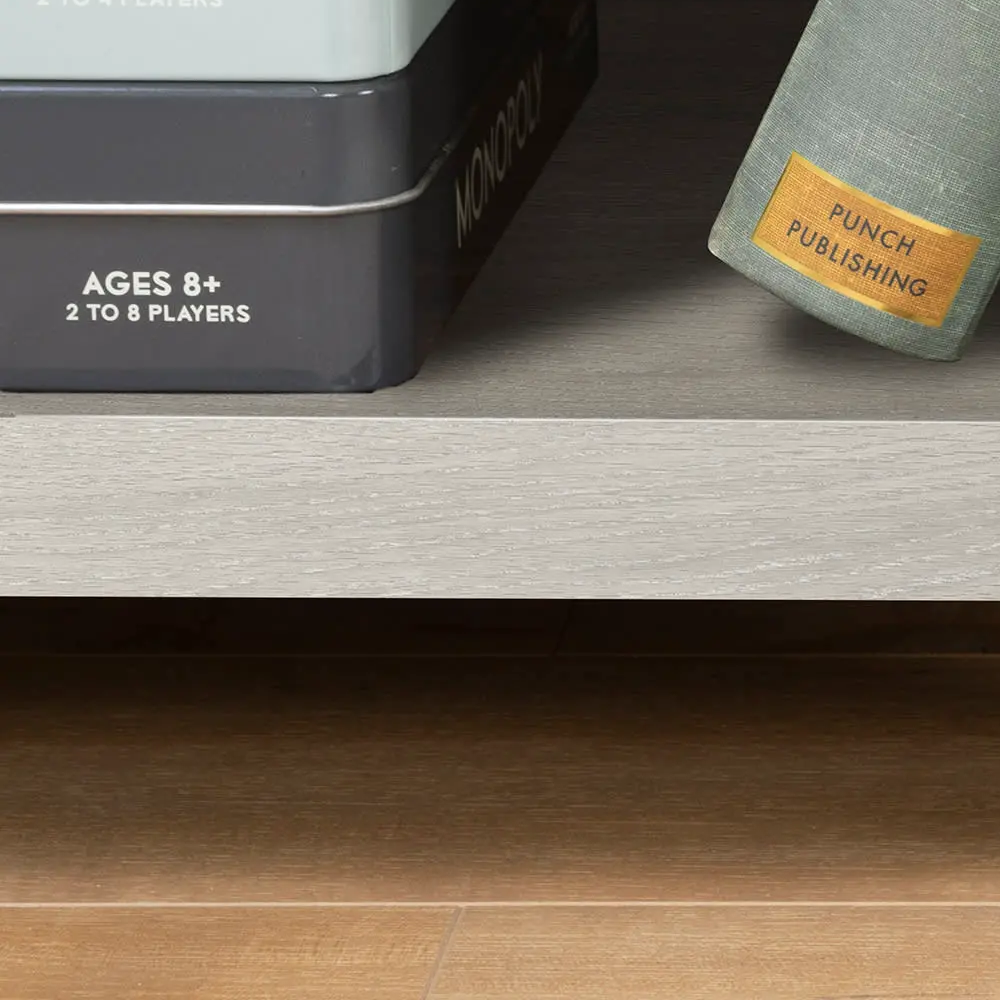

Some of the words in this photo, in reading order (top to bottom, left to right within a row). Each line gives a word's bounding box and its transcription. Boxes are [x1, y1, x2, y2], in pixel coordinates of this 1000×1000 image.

[455, 48, 544, 249] MONOPOLY
[828, 202, 917, 257] PUNCH
[81, 270, 173, 297] AGES
[182, 270, 222, 297] 8+
[786, 219, 929, 298] PUBLISHING
[65, 302, 80, 322] 2
[85, 302, 121, 322] TO
[127, 302, 142, 323] 8
[148, 303, 252, 324] PLAYERS
